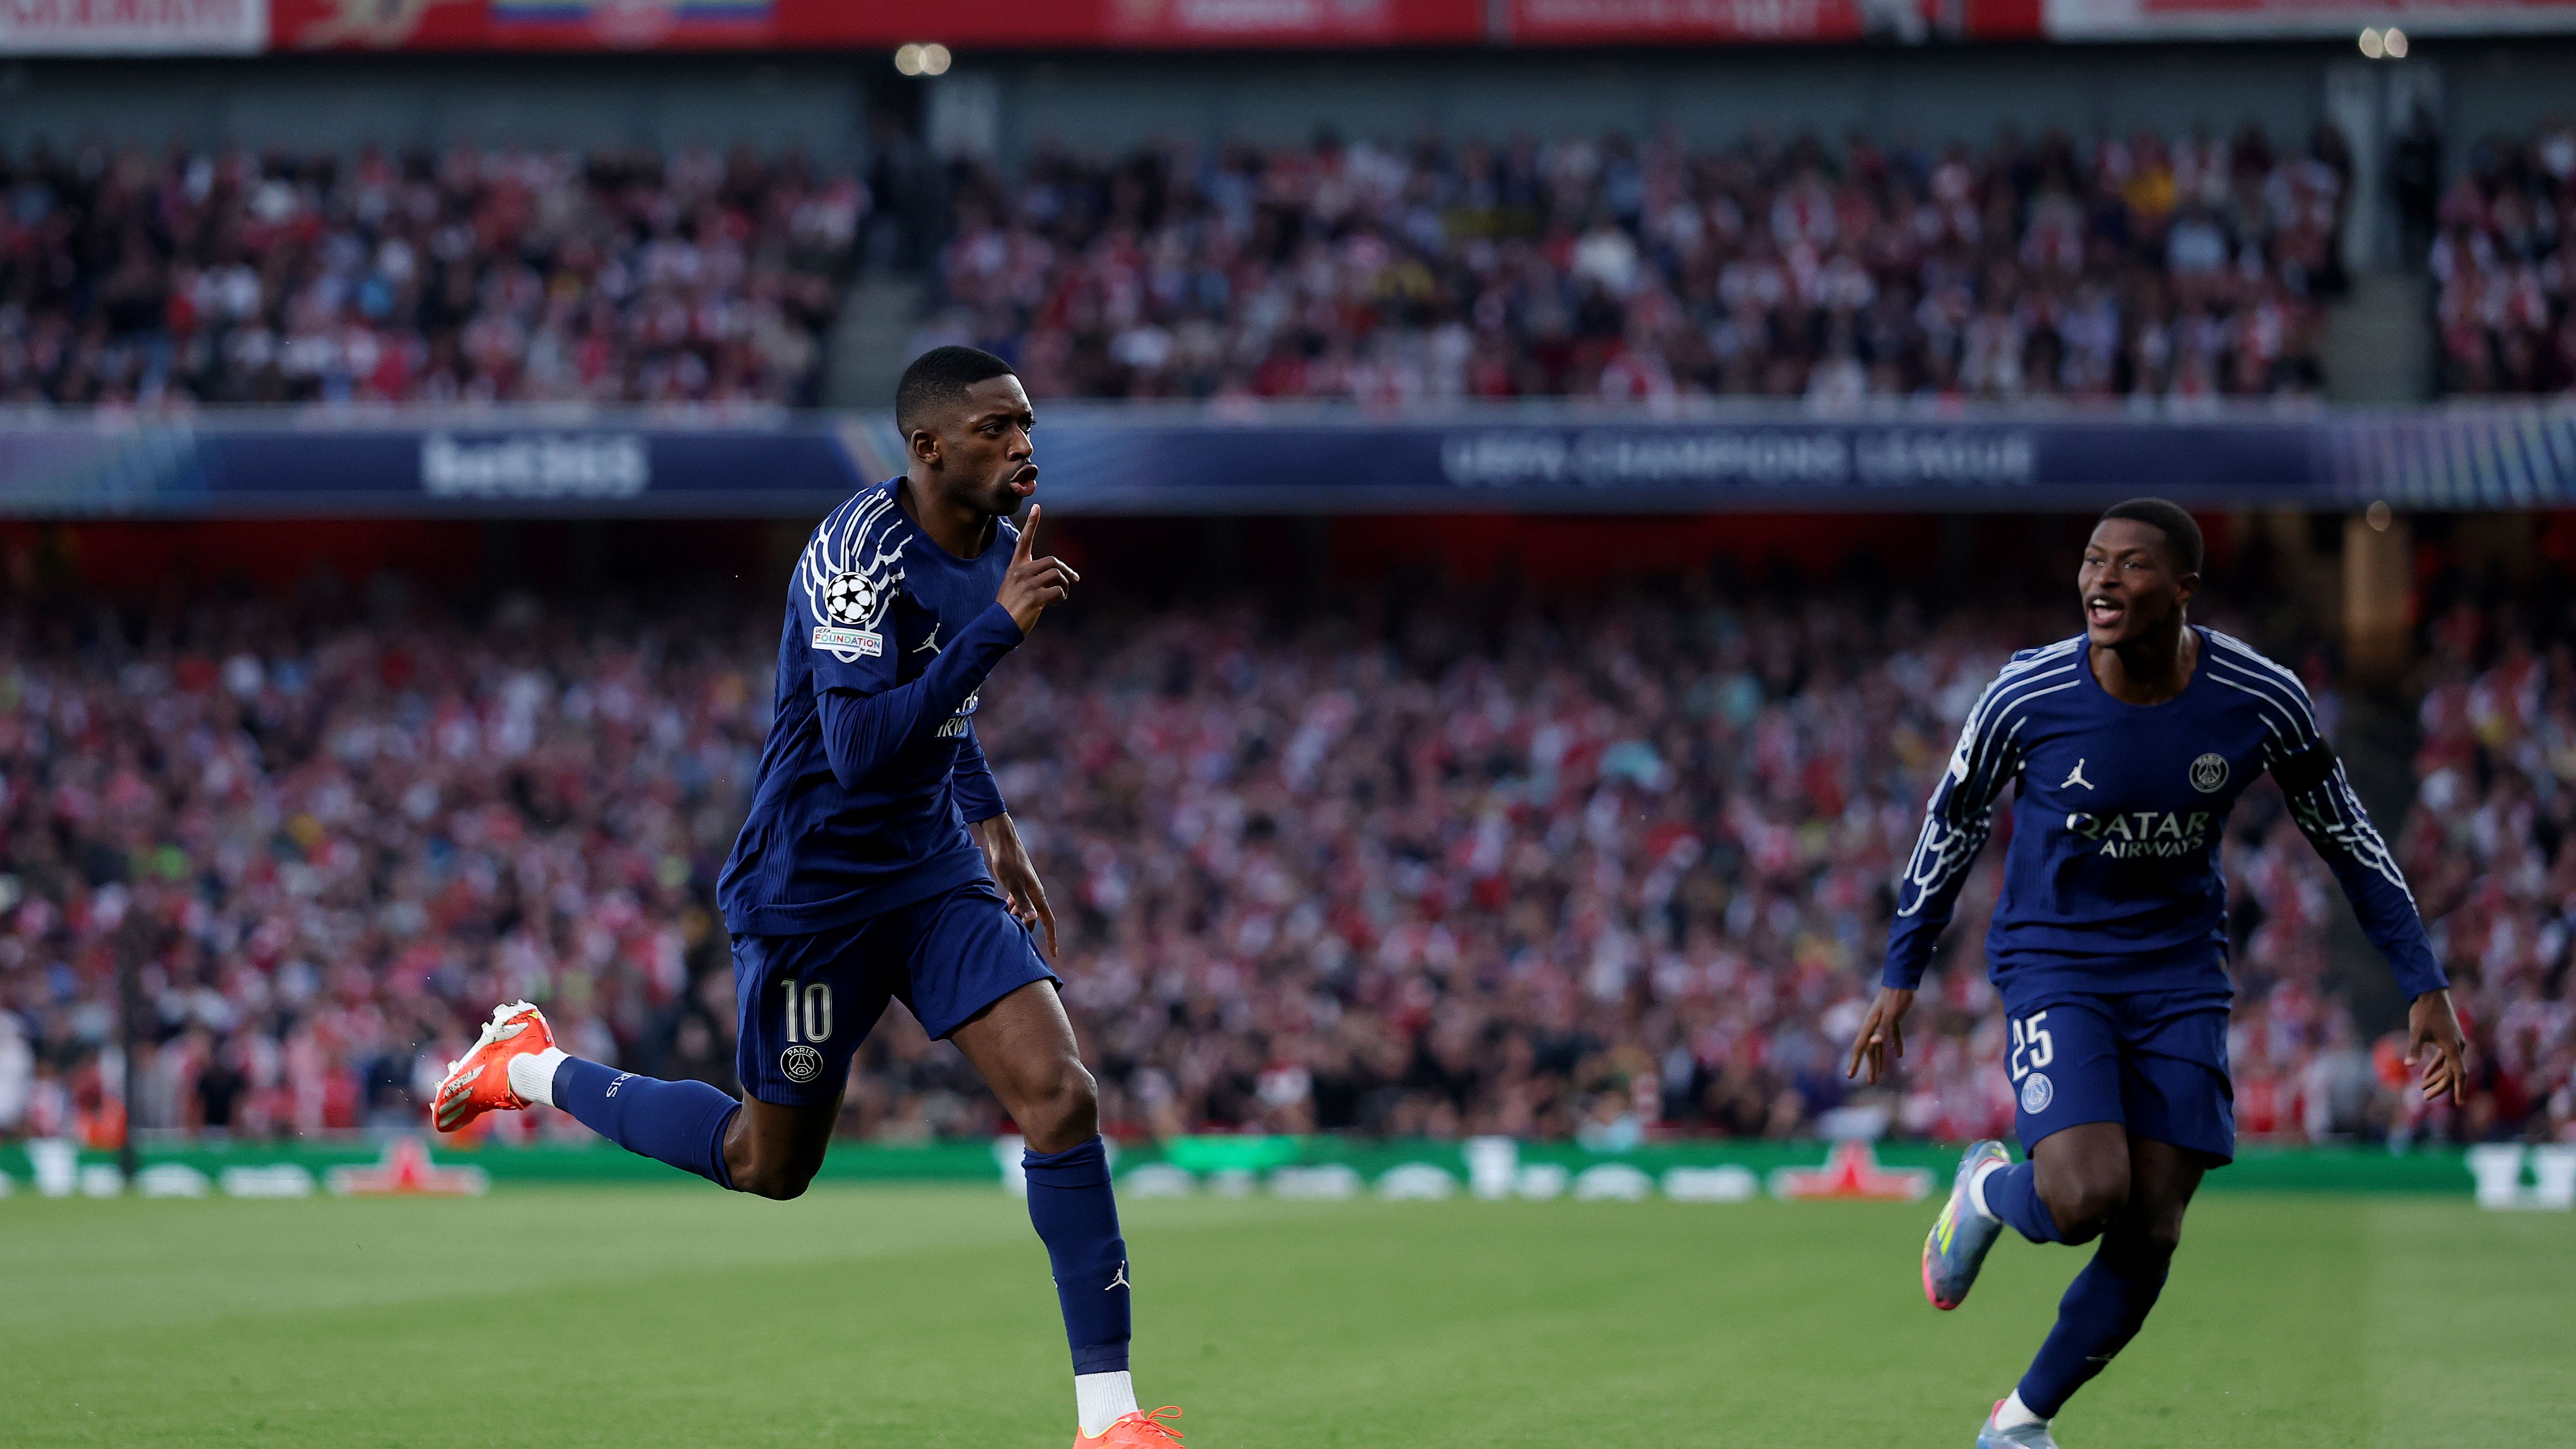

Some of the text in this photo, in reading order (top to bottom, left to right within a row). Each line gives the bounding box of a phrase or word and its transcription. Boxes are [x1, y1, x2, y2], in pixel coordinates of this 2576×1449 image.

[2066, 812, 2210, 840] QATAR
[2100, 835, 2204, 859] AIRWAYS
[781, 979, 832, 1043] 10
[787, 1047, 815, 1057] PARIS
[2012, 1010, 2054, 1082] 25
